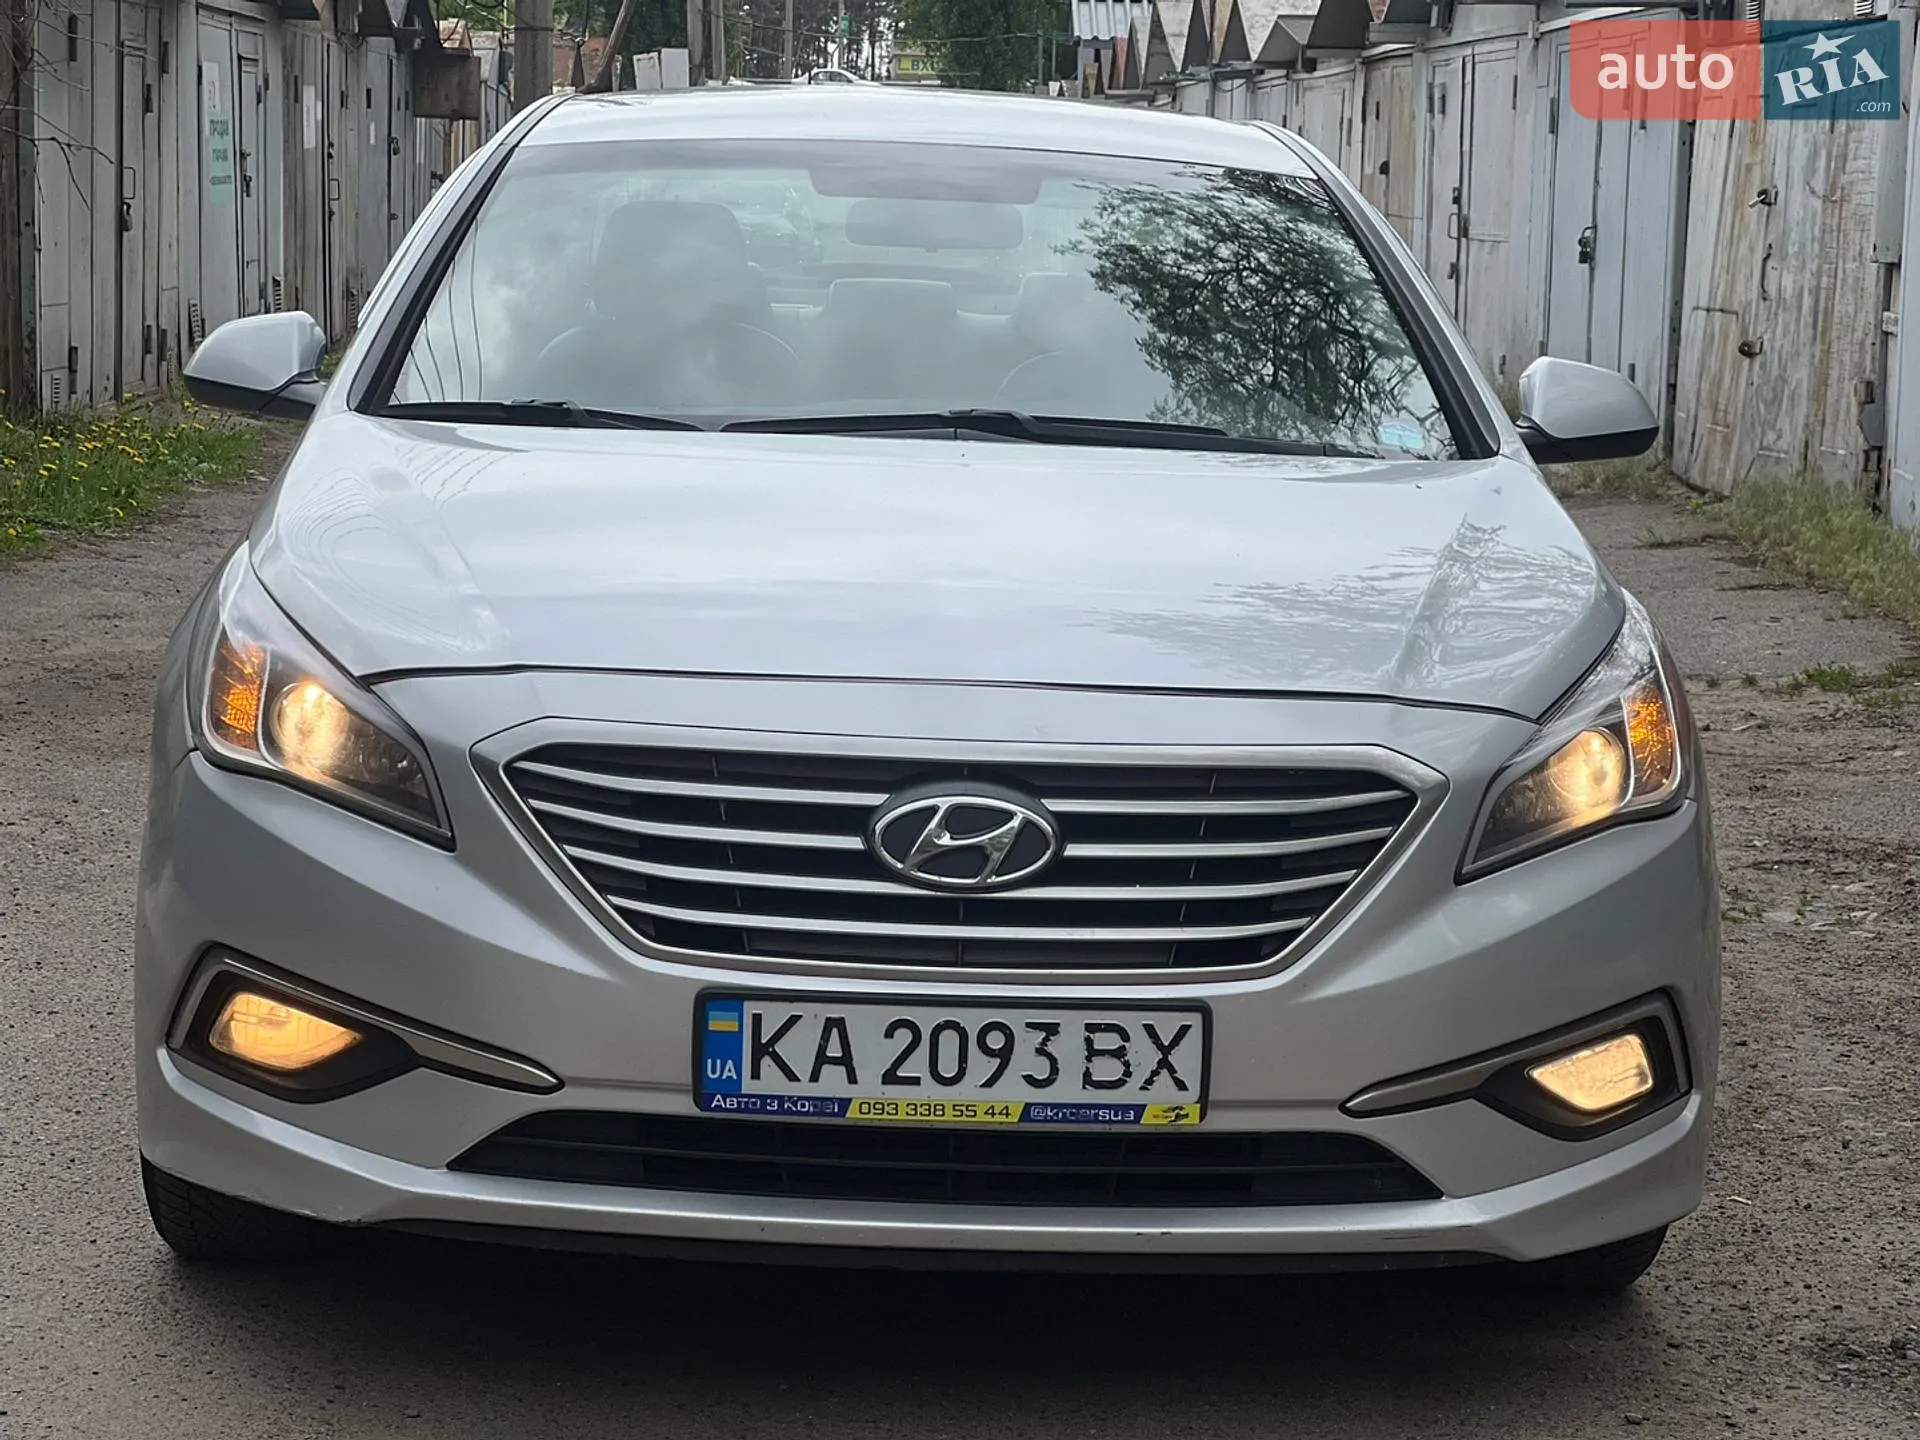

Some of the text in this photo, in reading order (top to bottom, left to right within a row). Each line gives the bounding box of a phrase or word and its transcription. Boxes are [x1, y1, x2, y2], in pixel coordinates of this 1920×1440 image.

[750, 1012, 1193, 1092] KA 2093 BX
[706, 1058, 738, 1081] UA
[859, 1100, 1012, 1119] 093 338 55 44
